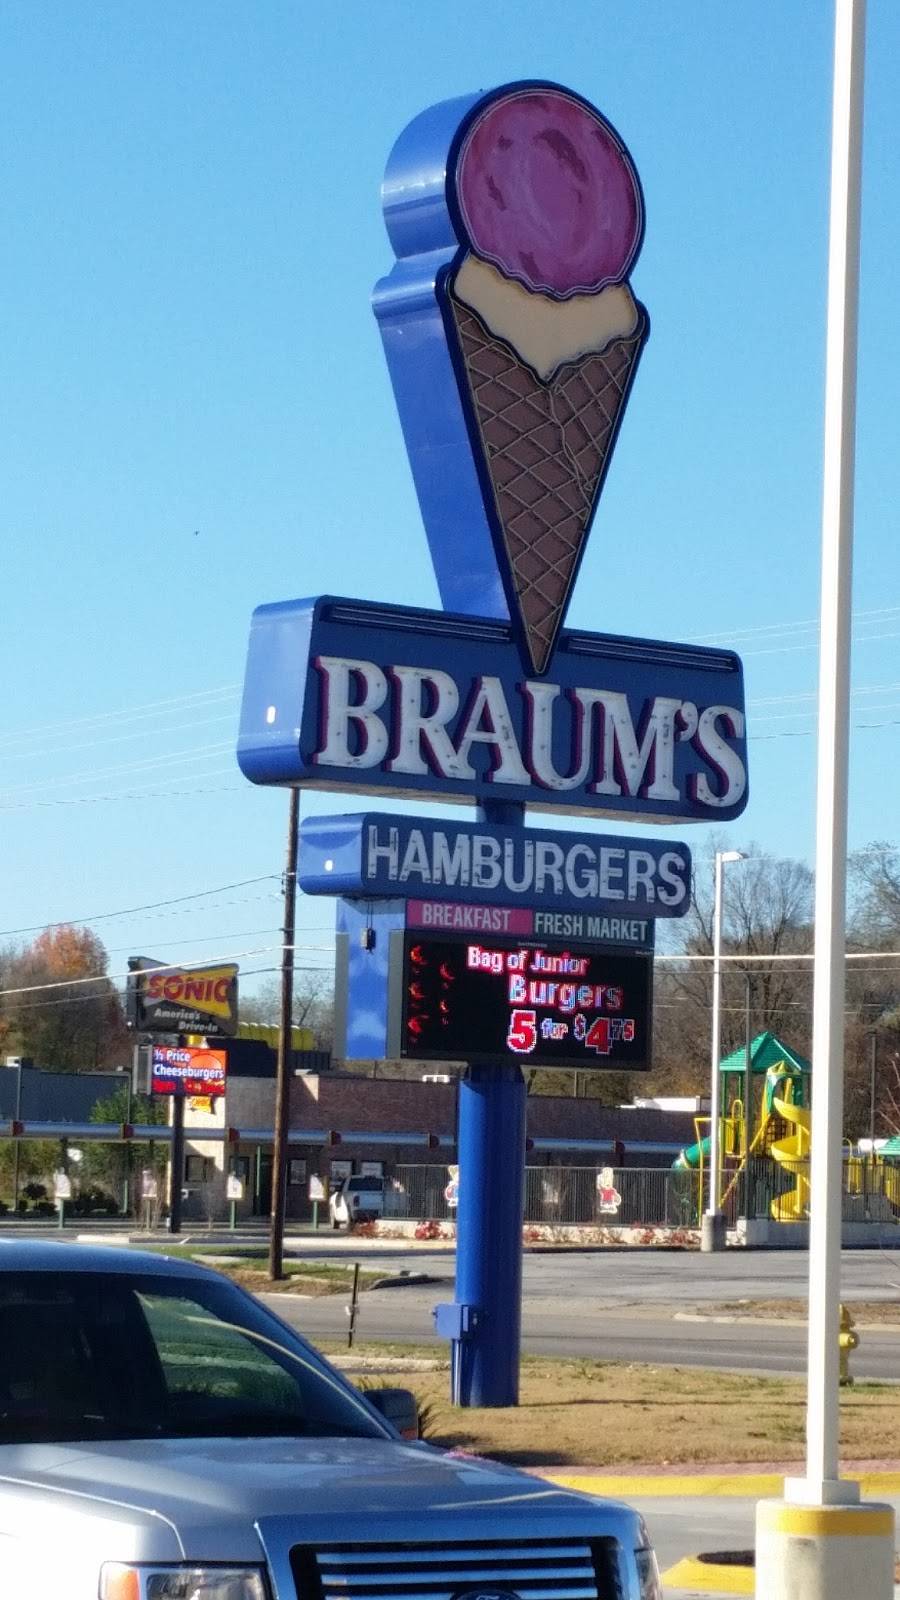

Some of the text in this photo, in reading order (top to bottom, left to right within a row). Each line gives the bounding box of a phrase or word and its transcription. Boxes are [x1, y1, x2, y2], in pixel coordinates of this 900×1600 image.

[314, 656, 747, 808] BRAUM'S
[367, 824, 689, 906] HAMBURGERS
[421, 903, 511, 932] BREAKFAST
[535, 912, 648, 942] FRESH MARKET
[467, 945, 590, 975] Bag of Junior
[147, 973, 231, 1003] SONIC
[508, 974, 622, 1012] Burgers
[154, 1007, 201, 1020] America's
[506, 1009, 537, 1053] 5
[541, 1018, 568, 1039] for
[166, 1049, 191, 1062] Price
[153, 1063, 224, 1080] Cheeseburgers
